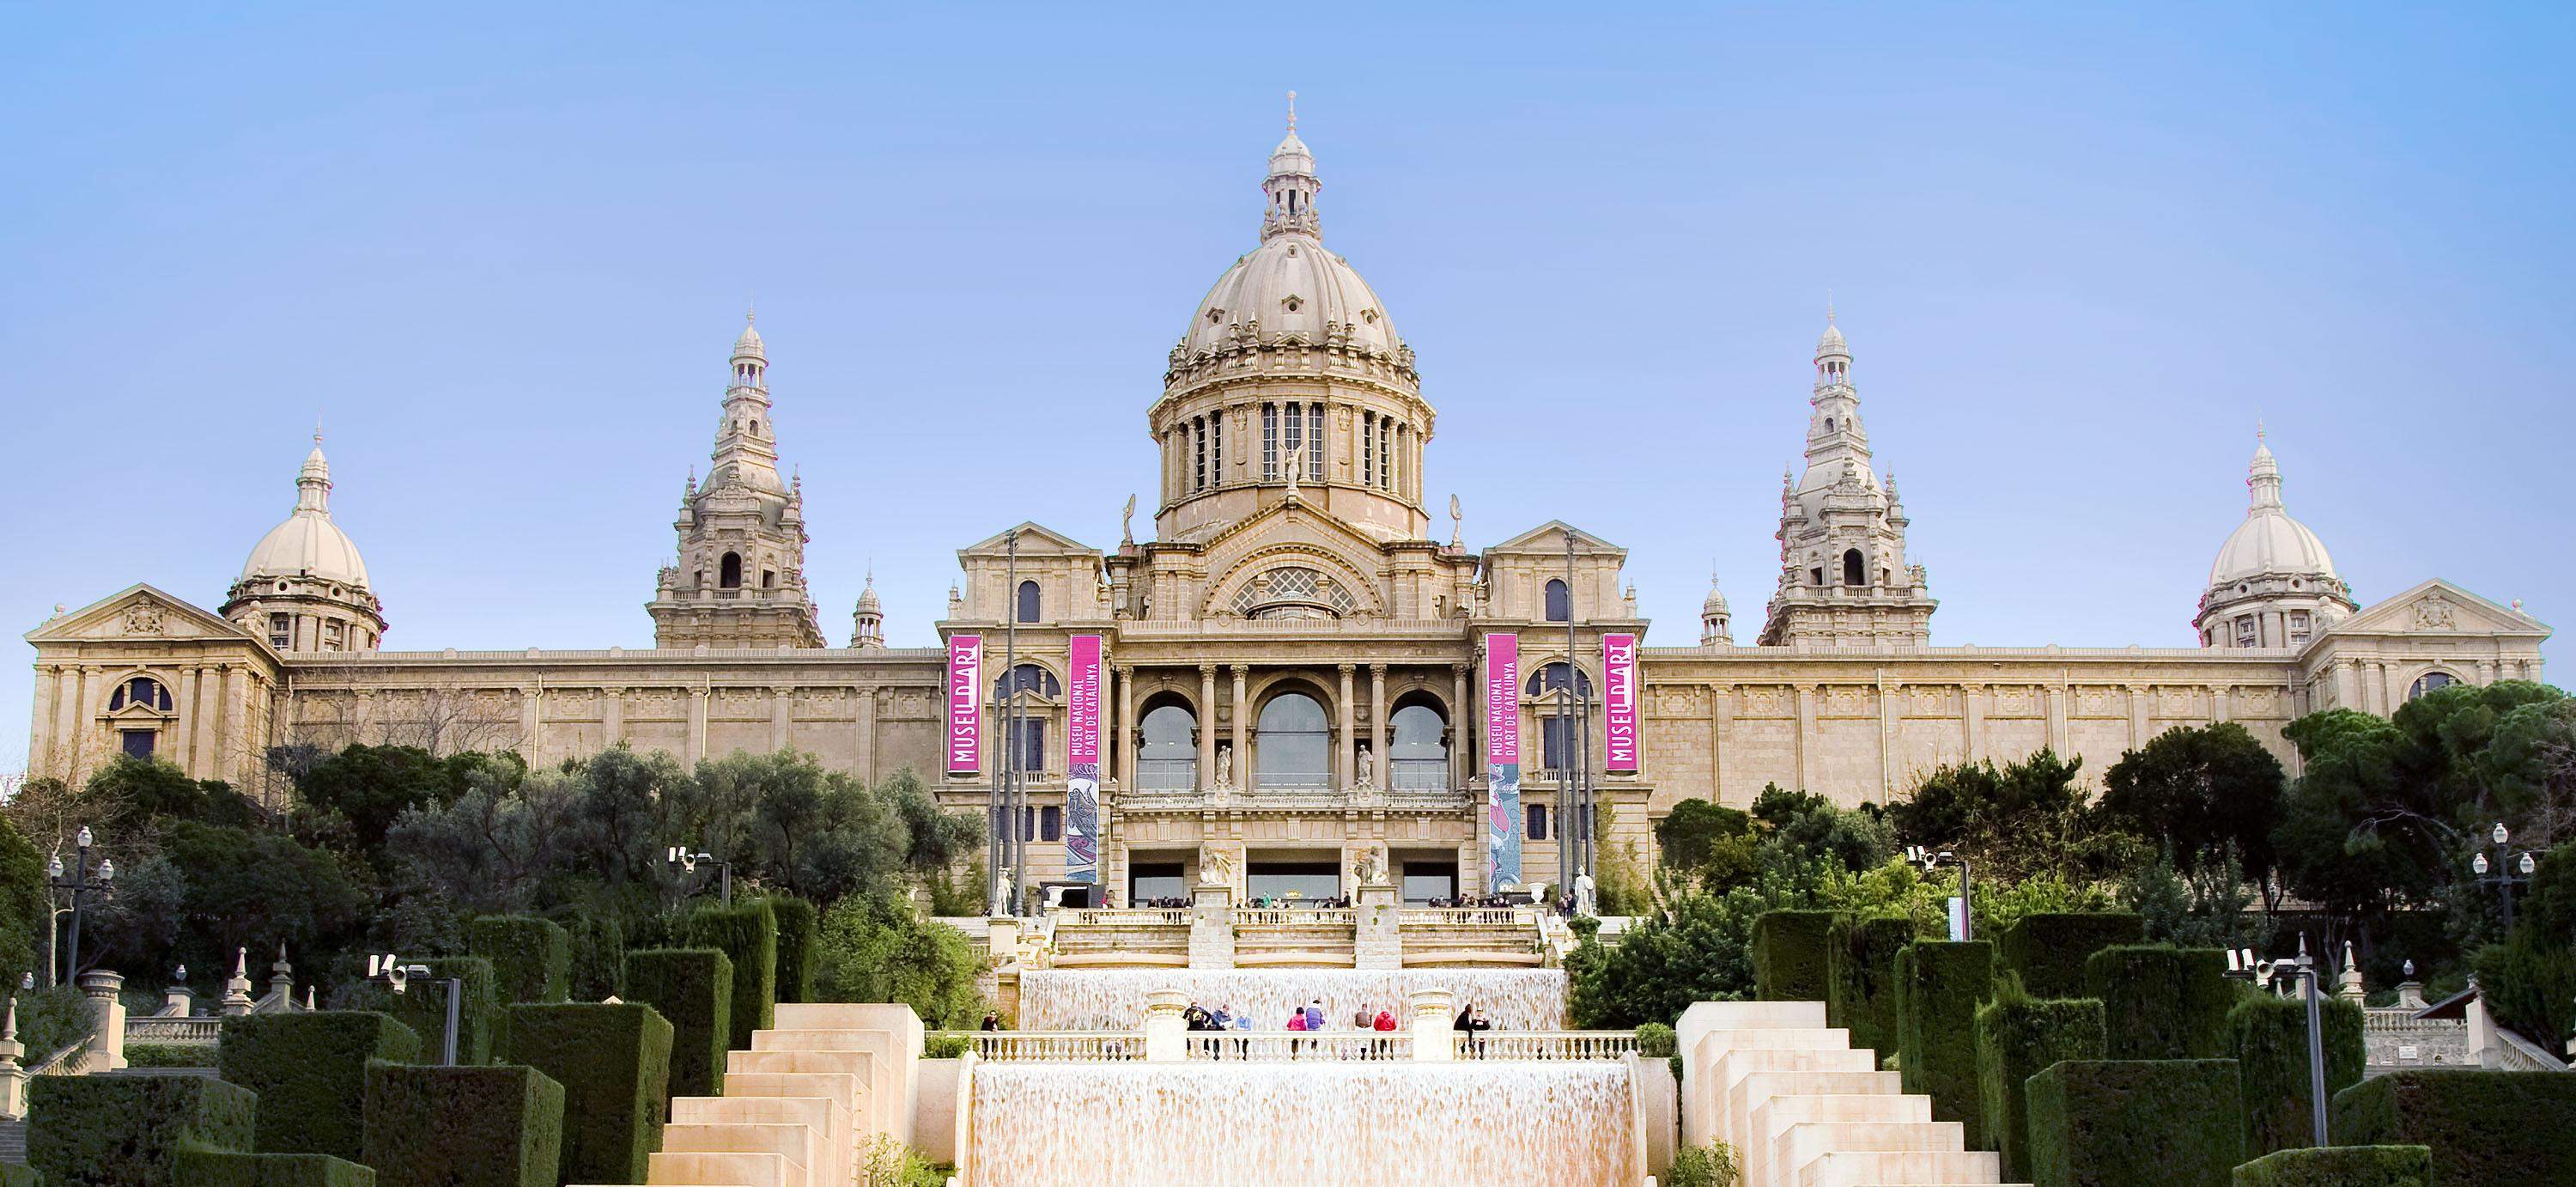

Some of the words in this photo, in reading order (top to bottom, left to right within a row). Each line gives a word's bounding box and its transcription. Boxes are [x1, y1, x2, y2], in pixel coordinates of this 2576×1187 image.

[955, 644, 977, 697] D'ART
[1086, 663, 1097, 712] CATALUNYA
[1504, 662, 1516, 712] CATALUNYA
[1609, 644, 1631, 695] D'ART
[1072, 679, 1084, 723] NACIONAL
[1085, 715, 1097, 726] DE
[1492, 679, 1502, 722] NACIONAL
[1505, 715, 1516, 726] DE
[954, 703, 975, 762] MUSEU
[1071, 725, 1083, 756] MUSEU
[1084, 729, 1096, 756] D'ART
[1491, 726, 1502, 756] MUSEU
[1505, 729, 1516, 756] D'ART
[1610, 703, 1632, 762] MUSEU
